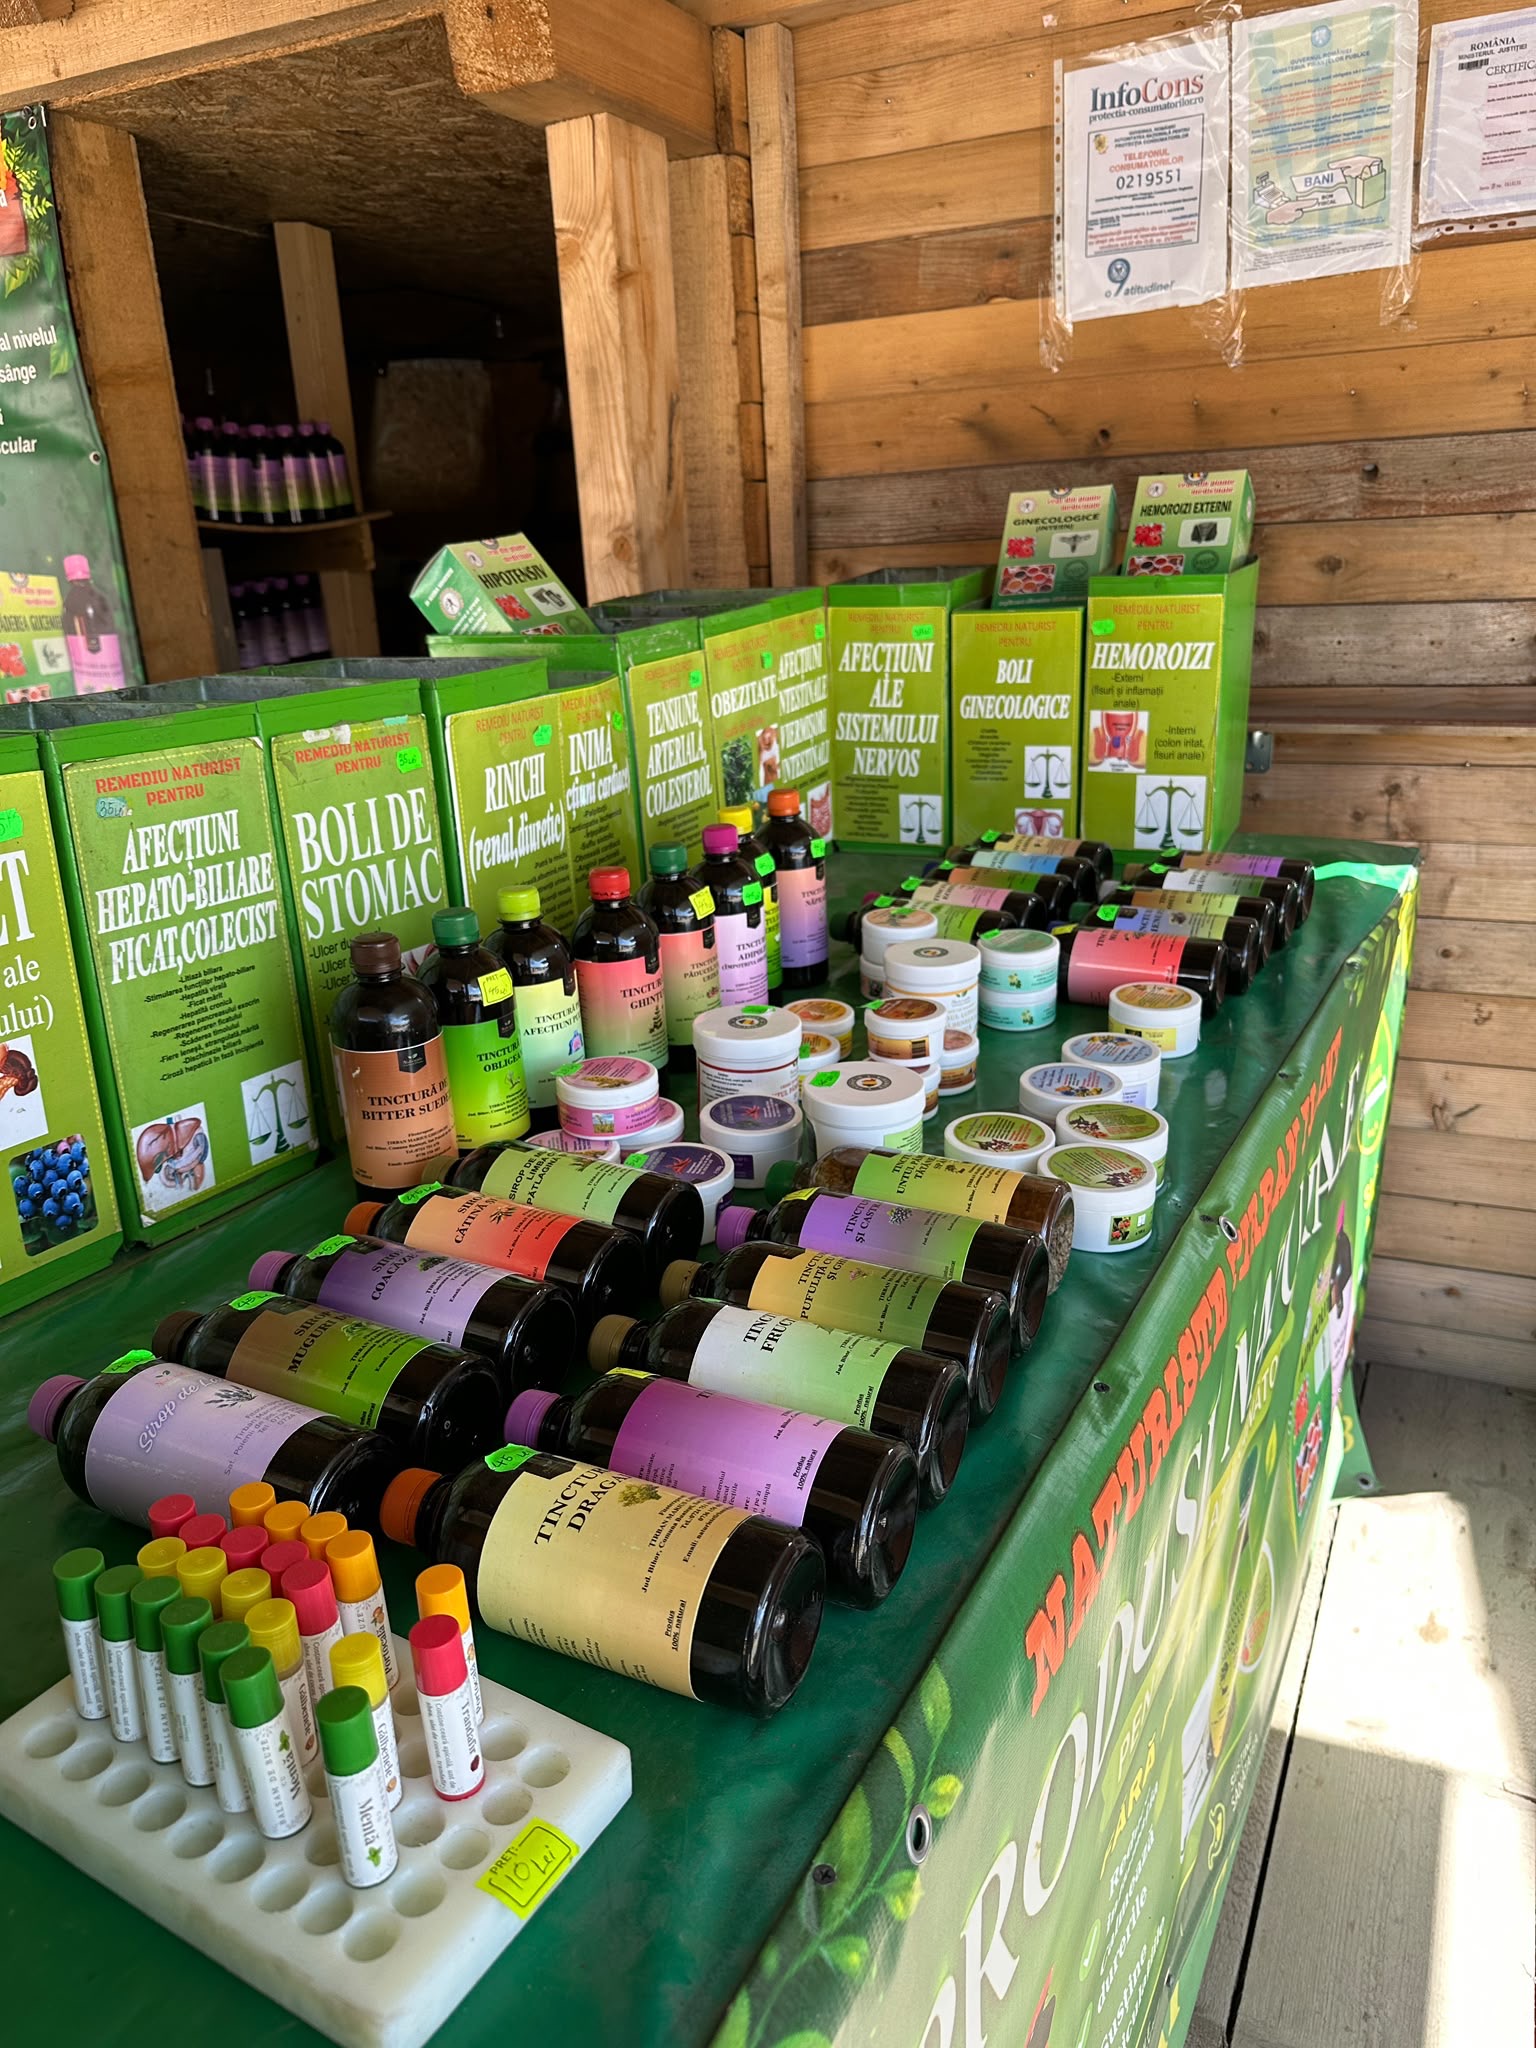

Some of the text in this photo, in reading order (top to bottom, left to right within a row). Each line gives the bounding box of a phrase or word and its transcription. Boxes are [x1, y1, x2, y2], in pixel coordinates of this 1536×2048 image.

[1458, 49, 1495, 60] MINISTERUL
[1470, 37, 1516, 51] ROMÂNIA
[1090, 74, 1204, 112] InfoCons
[1089, 96, 1204, 124] protectia-consumatorilor.ro
[1109, 155, 1184, 173] CONSUMATORILOR
[1123, 148, 1169, 161] TELEFONUL
[1116, 169, 1181, 190] 0219551
[1304, 173, 1334, 187] BANI
[13, 325, 57, 350] nivelul
[0, 358, 37, 385] sânge
[1012, 512, 1100, 527] GINECOLOGICE
[1139, 500, 1232, 517] HEMOROIZI EXTERNI
[478, 564, 548, 589] HIPOTENSIV
[1113, 604, 1200, 614] REMEDIU NATURIST
[1014, 621, 1056, 632] NATURIST
[1137, 621, 1173, 631] PENTRU
[998, 637, 1032, 648] PENTRU
[1091, 641, 1216, 670] HEMOROIZI
[995, 659, 1034, 684] BOLI
[712, 674, 778, 719] OBEZITATE
[869, 679, 904, 708] ALE
[476, 706, 544, 732] REMEDIU NATURIST
[960, 695, 1071, 720] GINECOLOGICE
[500, 731, 527, 745] PENTRU
[836, 712, 939, 743] SISTEMULUI
[295, 732, 410, 764] REMEDIU NATURIST
[96, 757, 241, 794] REMEDIU NATURIST
[335, 755, 381, 775] PENTRU
[852, 747, 921, 777] NERVOS
[146, 783, 205, 806] PENTRU
[484, 752, 546, 814] RINICHI
[647, 764, 713, 818] COLESTEROL
[292, 787, 432, 874] BOLI DE
[95, 852, 275, 934] HEPATO-BILIARE
[301, 847, 442, 942] STOMAC
[109, 900, 277, 985] FICAT,COLECIST
[309, 938, 339, 959] -Ulcer
[3, 954, 40, 988] ale
[318, 955, 347, 975] -Ulcer
[322, 972, 350, 991] -Ulcer
[368, 1082, 438, 1107] TINCTURĂ
[361, 1105, 415, 1121] BITTER
[509, 1155, 536, 1200] SIROP DE
[527, 1155, 547, 1181] LIMBA
[897, 1169, 911, 1194] UNTUL
[454, 1202, 486, 1243] CĂTINĂ
[294, 1310, 331, 1336] SIROP
[288, 1318, 333, 1373] MUGURI
[854, 1393, 864, 1415] Produs
[859, 1386, 875, 1428] 100% natural
[138, 1383, 198, 1453] Sirop de
[492, 1456, 512, 1470] 45
[793, 1456, 806, 1477] Produs
[797, 1448, 817, 1491] 100% natural
[1024, 1265, 1228, 1718] NATURISTE
[649, 1520, 668, 1548] TIRBAN
[642, 1522, 678, 1593] Jud. Comuna
[683, 1539, 698, 1563] Email:
[665, 1610, 675, 1637] Produs
[671, 1600, 686, 1652] 100% natural
[159, 1697, 166, 1708] DE
[299, 1683, 311, 1736] Gălbenele
[160, 1713, 171, 1751] BALSAM
[462, 1702, 477, 1755] Trandafir
[378, 1722, 392, 1778] Gălbenele
[261, 1740, 285, 1825] BALSAM DE BUZE
[358, 1797, 379, 1847] Mentă
[505, 1844, 555, 1890] 10 Lei
[1098, 1886, 1148, 2014] durerile
